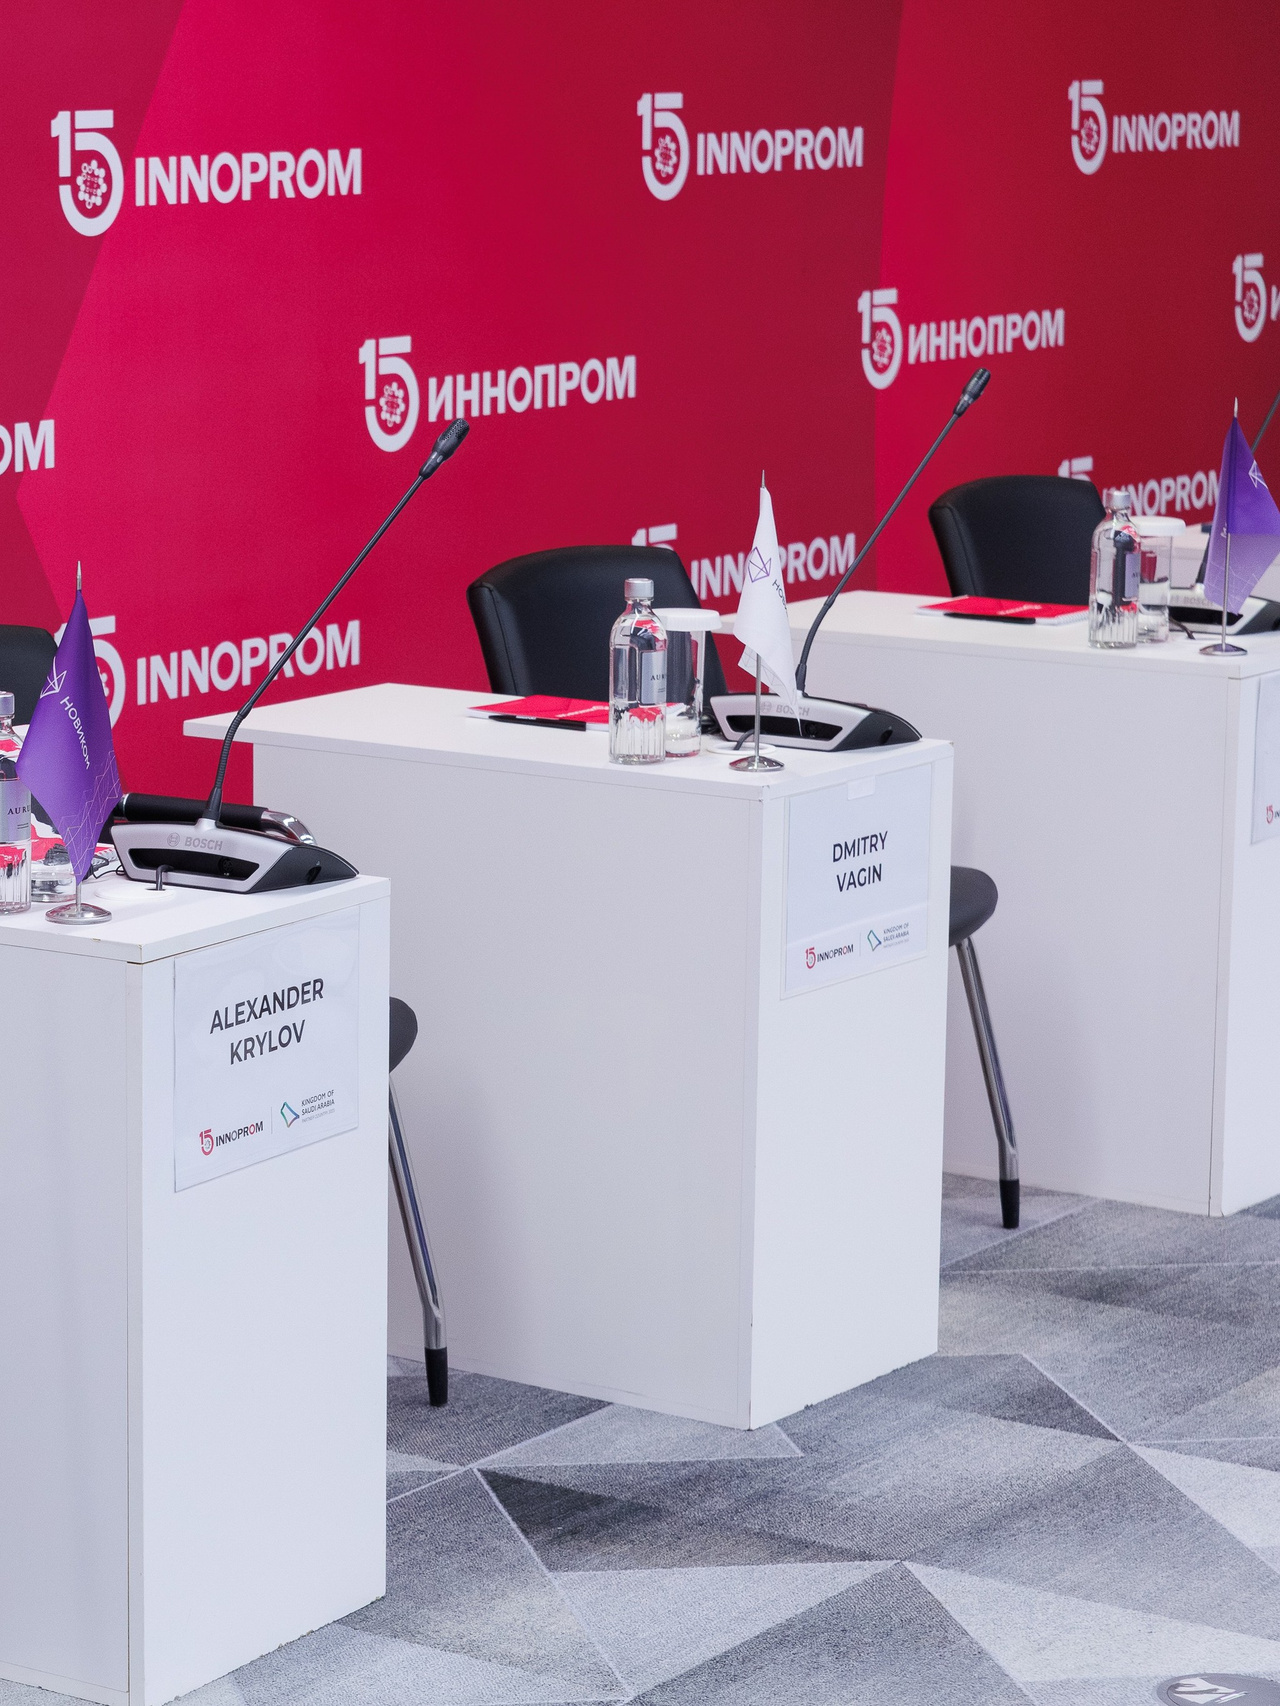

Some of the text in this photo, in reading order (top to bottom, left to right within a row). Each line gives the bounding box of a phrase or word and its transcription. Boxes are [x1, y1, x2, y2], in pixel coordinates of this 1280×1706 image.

[636, 92, 864, 201] 15 INNOPROM
[1067, 80, 1240, 175] 15 INNOPROM
[51, 109, 362, 237] 15 INNOPROM
[1232, 253, 1267, 343] 15
[857, 288, 1065, 390] 15 ИННОПРОМ
[359, 336, 637, 453] 15 ИННОПРОМ
[691, 532, 856, 600] INNROM
[136, 619, 360, 706] INNOPROM
[7, 804, 31, 815] AURU
[184, 835, 224, 851] BOSCH
[832, 830, 888, 863] DMITRY
[836, 863, 882, 893] VAGIN
[805, 943, 854, 970] 15 INNOPROM
[209, 977, 324, 1035] ALEXANDER
[230, 1019, 306, 1066] KRYLOV
[301, 1089, 335, 1107] KINGDOM OF
[301, 1104, 317, 1116] SAUDI
[317, 1099, 335, 1111] ARABIA
[199, 1120, 264, 1156] 15 INNOPROM
